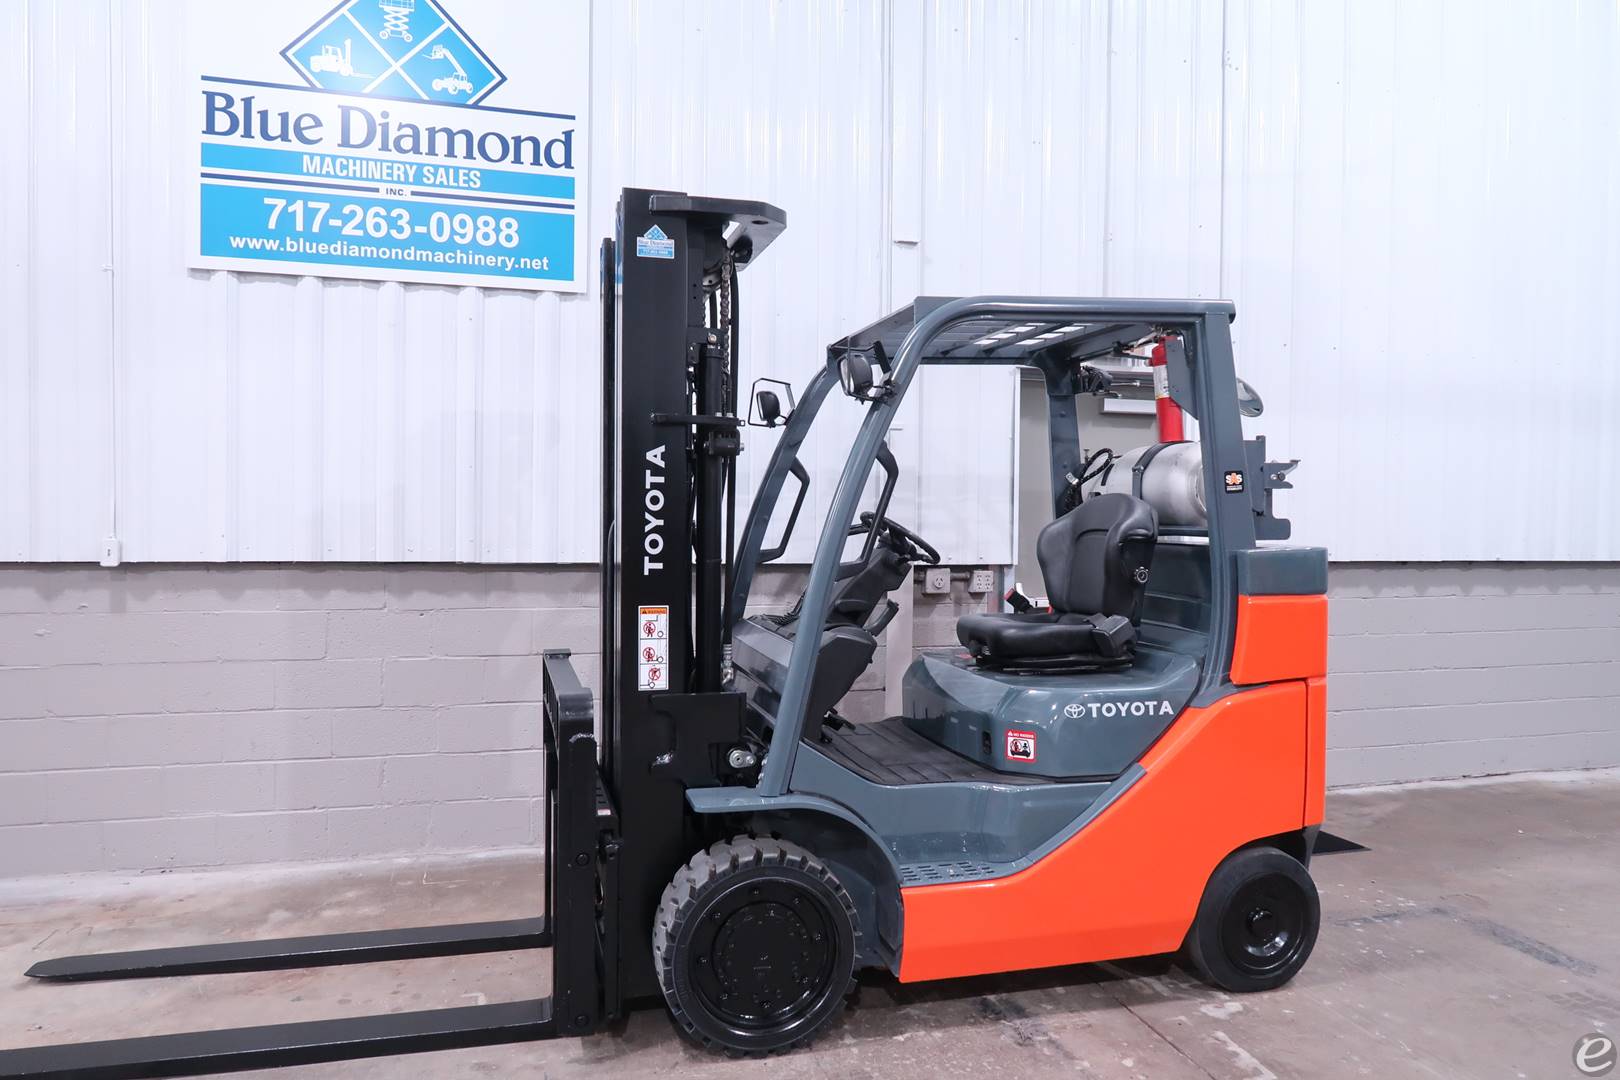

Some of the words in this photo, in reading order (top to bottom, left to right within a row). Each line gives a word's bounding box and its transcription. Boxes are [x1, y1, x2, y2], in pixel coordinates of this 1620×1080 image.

[202, 90, 323, 145] Blue
[337, 104, 575, 170] Diamond
[302, 154, 417, 183] MACHINERY
[422, 165, 481, 188] SALES
[385, 187, 408, 197] INC.
[263, 197, 520, 249] 717-263-0988
[229, 235, 550, 272] www.bluediamondmachinery.net
[643, 444, 666, 576] TOYOTA
[1087, 700, 1175, 718] TOYOTA
